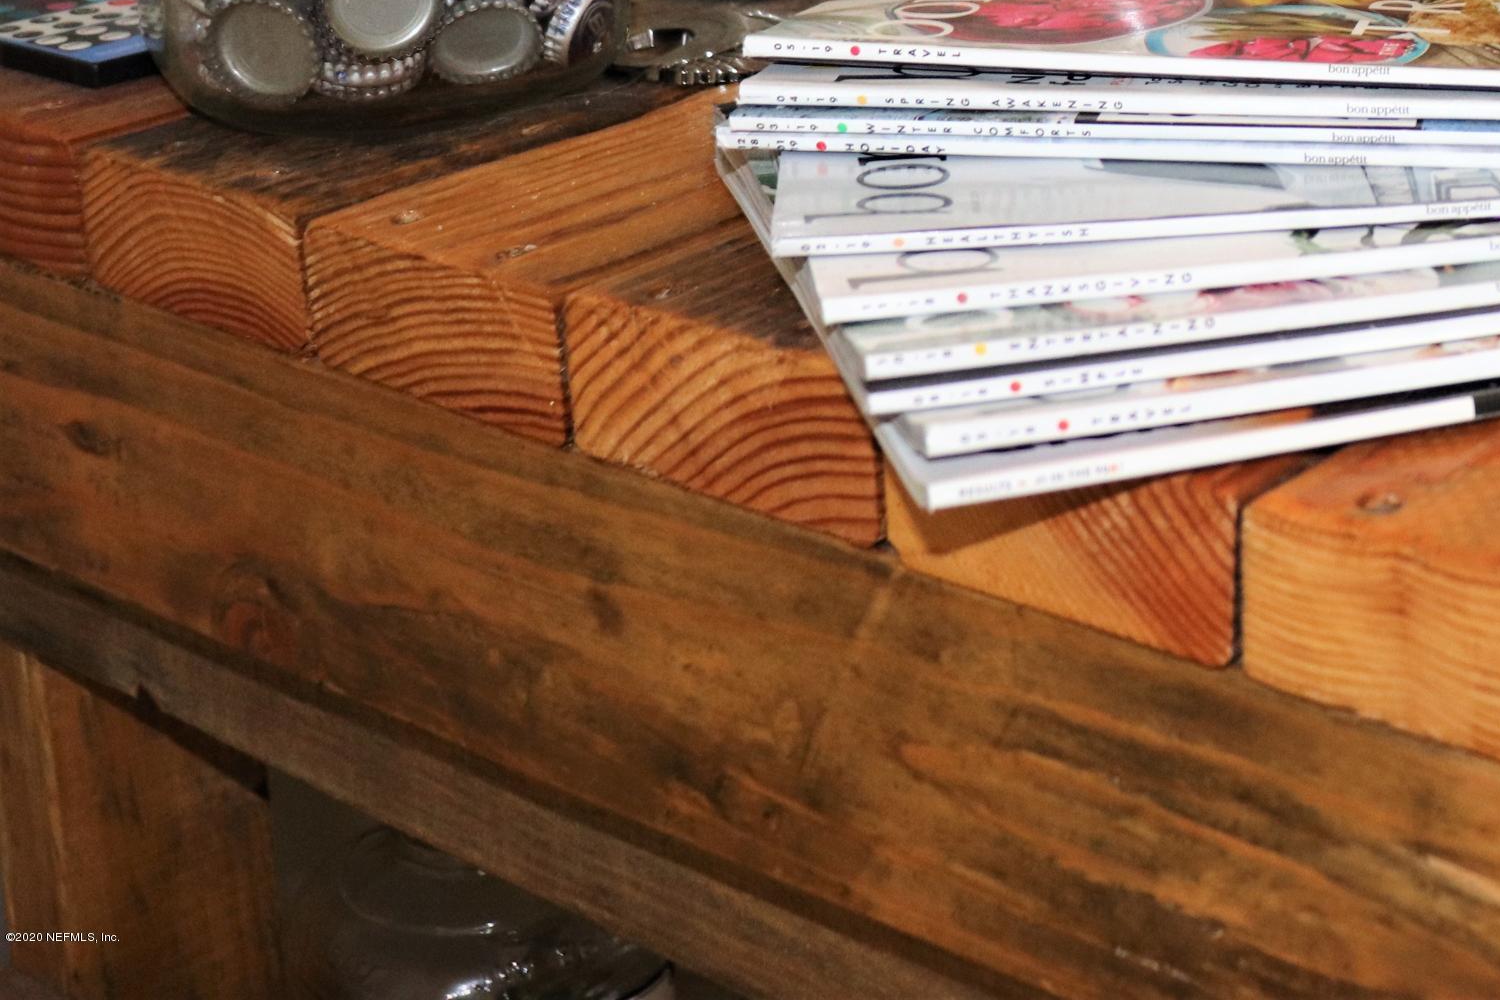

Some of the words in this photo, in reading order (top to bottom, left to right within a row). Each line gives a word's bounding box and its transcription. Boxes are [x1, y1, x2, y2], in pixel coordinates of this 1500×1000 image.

[878, 48, 961, 58] TRAVEL
[1328, 63, 1350, 74] bon
[1351, 65, 1392, 78] appétit
[884, 97, 971, 107] SPRING
[991, 98, 1124, 110] AWAKENING
[1346, 102, 1369, 114] bon
[1370, 104, 1411, 117] appétit
[865, 122, 953, 134] WINTER
[973, 126, 1092, 137] COMFORTS
[1331, 131, 1355, 143] bon
[1356, 132, 1396, 145] appétit
[845, 142, 947, 153] HOLIDAY
[1304, 152, 1326, 163] bon
[1327, 154, 1368, 166] appétit
[1425, 202, 1450, 216] bon
[925, 228, 1091, 246] HEALTHYISH
[989, 273, 1194, 299] THANKSGIVING
[1009, 317, 1216, 350] ENTERTAINING
